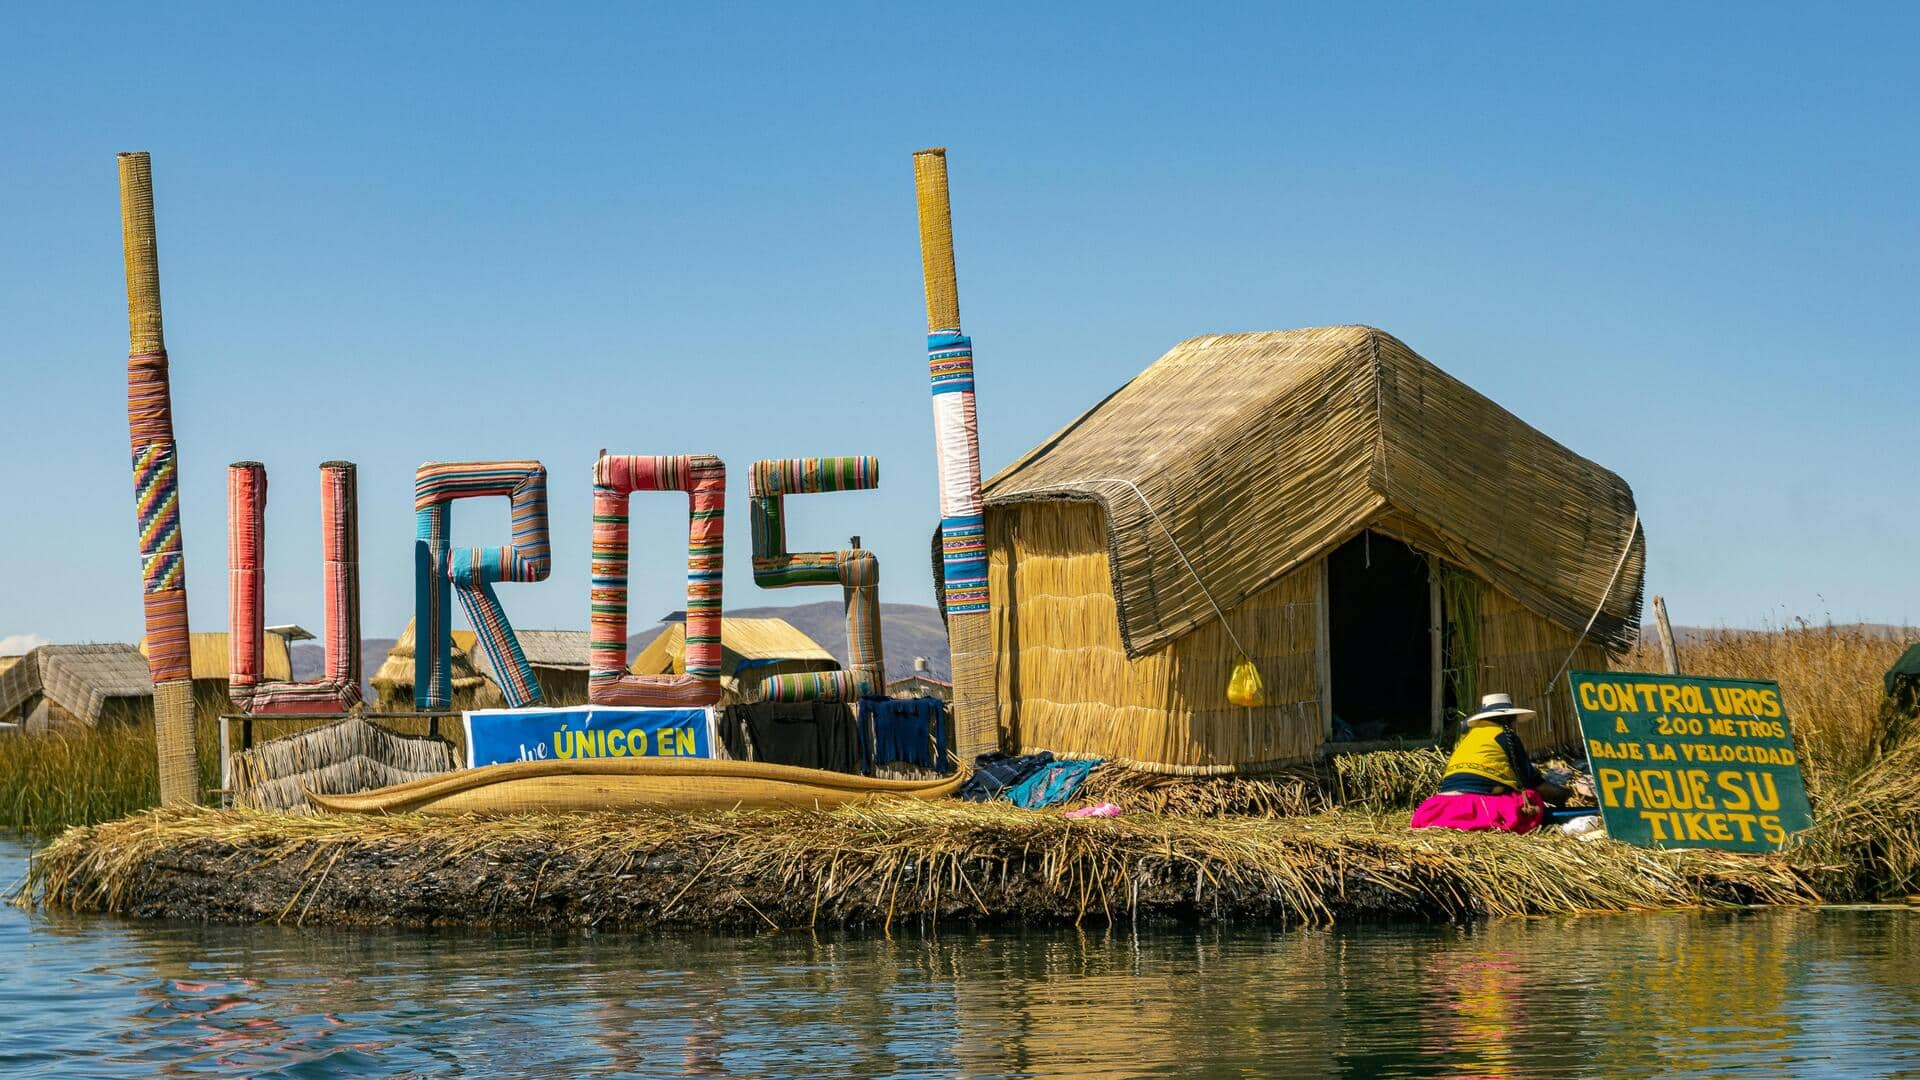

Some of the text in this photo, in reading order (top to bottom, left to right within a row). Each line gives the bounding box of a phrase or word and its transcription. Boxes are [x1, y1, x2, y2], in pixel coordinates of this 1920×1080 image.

[228, 454, 886, 714] UROS
[1579, 682, 1782, 718] CONTROL UROS
[553, 724, 648, 760] ÚNICO
[656, 727, 697, 756] EN
[1615, 717, 1786, 739] A 200 METROS
[1589, 740, 1796, 766] BAJE LA VELOCIDAD
[1599, 768, 1781, 812] PAGUE SU
[1640, 811, 1787, 844] TIKETS
